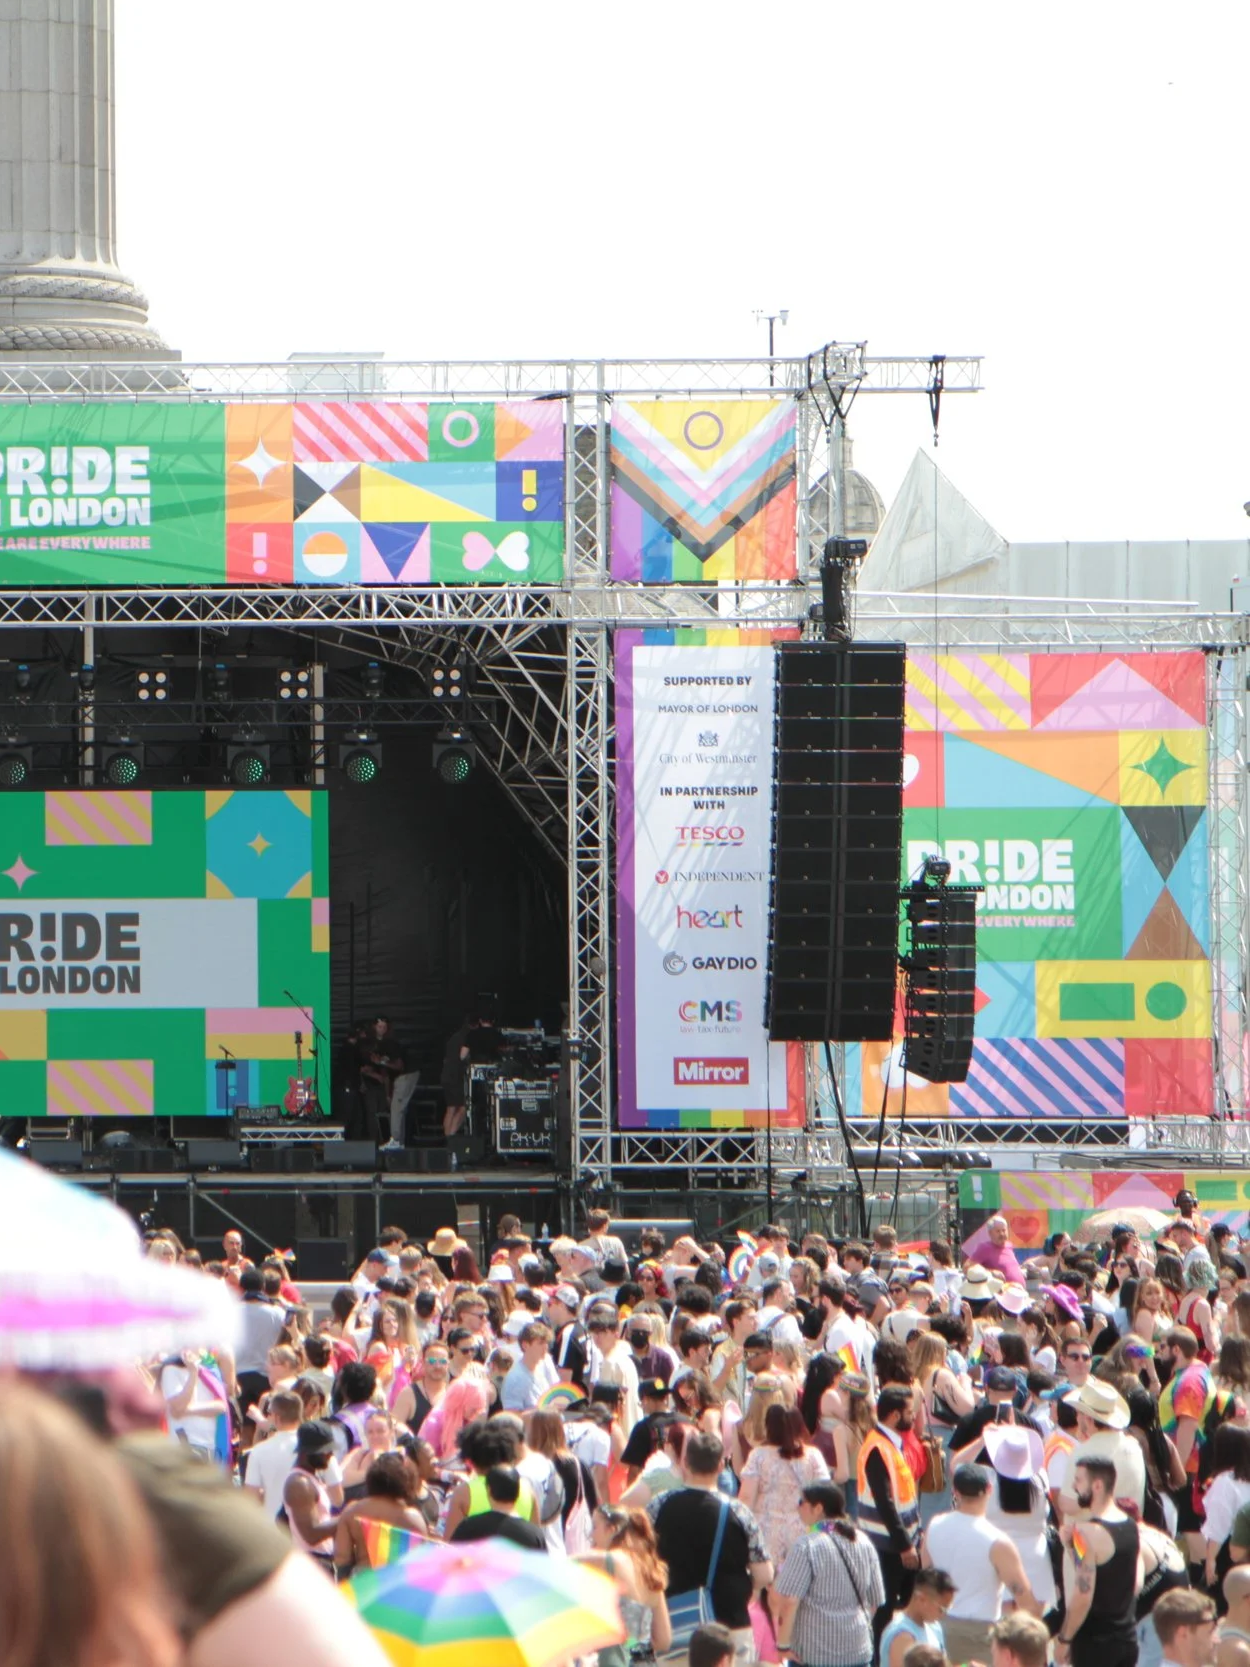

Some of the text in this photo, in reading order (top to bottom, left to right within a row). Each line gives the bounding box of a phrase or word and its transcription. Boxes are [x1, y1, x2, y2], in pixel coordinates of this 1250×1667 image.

[10, 497, 150, 527] LONDON
[664, 676, 752, 686] SUPPORTED BY
[658, 704, 758, 713] MAYOR OF LONDON
[659, 752, 758, 765] City of Westminster
[660, 786, 758, 796] IN PARTNERSHIP
[693, 800, 725, 810] WITH
[675, 826, 745, 840] TESCO
[674, 871, 765, 882] INDEPENDENT
[976, 884, 1075, 910] NDON
[677, 904, 743, 929] heart
[692, 957, 757, 970] GAYDIO
[0, 965, 141, 994] LONDON
[678, 1000, 742, 1023] CMS
[678, 1062, 744, 1081] Mirror
